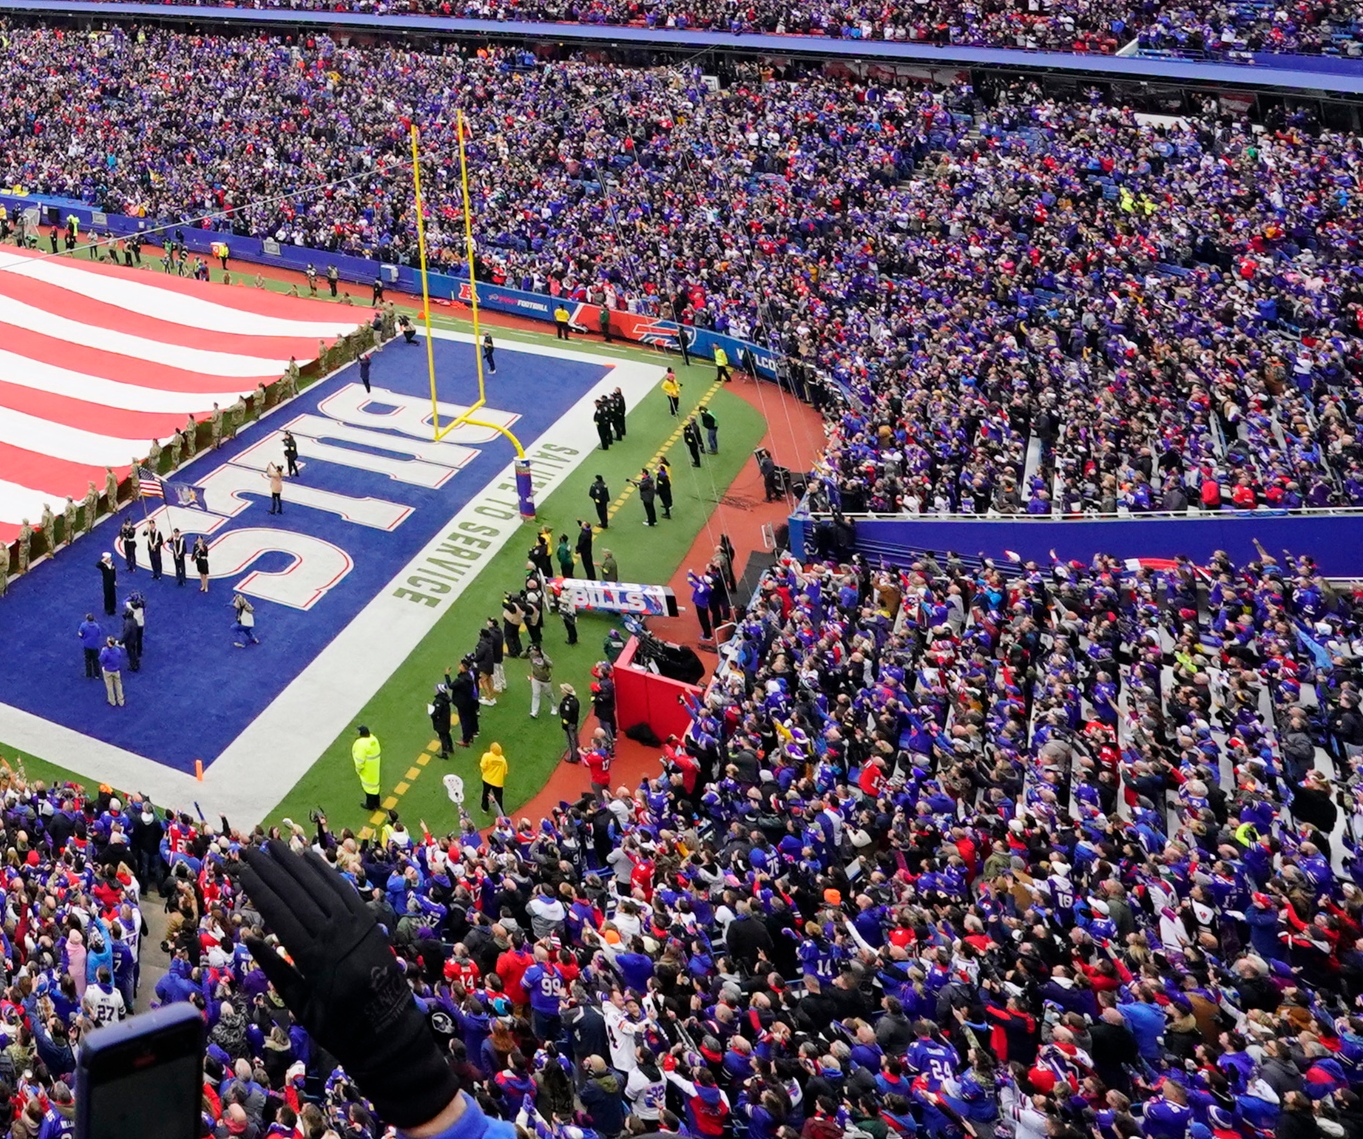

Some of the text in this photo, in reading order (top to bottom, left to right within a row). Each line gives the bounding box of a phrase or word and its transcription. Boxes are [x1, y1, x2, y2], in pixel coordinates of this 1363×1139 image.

[517, 299, 548, 312] FOOTBALL
[115, 382, 522, 611] BILLS
[474, 498, 520, 521] TO
[392, 521, 501, 608] SERVICE
[572, 588, 646, 612] BILLS
[817, 959, 833, 976] 14
[459, 974, 474, 989] 14
[541, 977, 561, 997] 99
[97, 1005, 115, 1020] 27
[929, 1059, 953, 1081] 24
